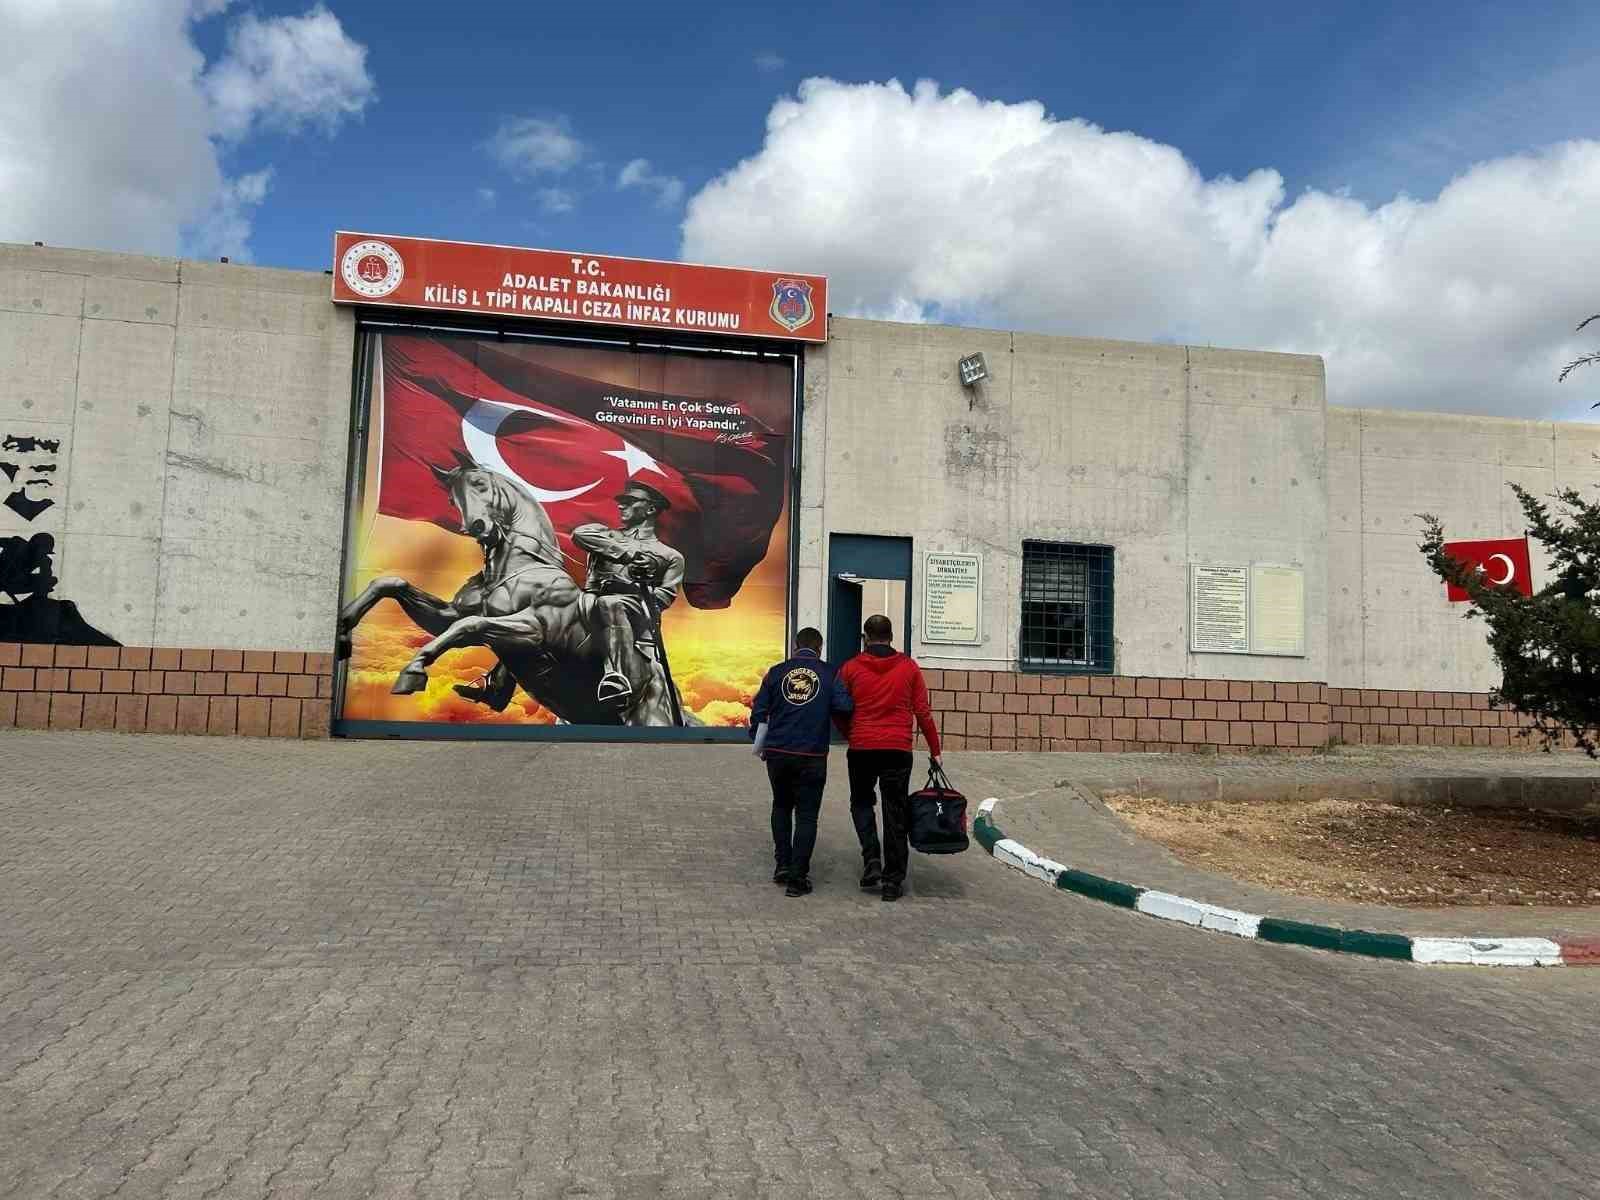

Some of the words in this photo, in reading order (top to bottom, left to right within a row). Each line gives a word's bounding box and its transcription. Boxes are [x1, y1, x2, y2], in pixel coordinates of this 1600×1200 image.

[572, 258, 605, 276] T.C.
[502, 273, 571, 293] ADALET
[577, 280, 670, 302] BAKANLIĞI
[424, 284, 467, 305] KİLİS
[472, 291, 480, 305] L
[486, 289, 517, 308] TİPİ
[523, 294, 577, 314] KAPALI
[583, 300, 622, 318] CEZA
[627, 301, 671, 323] İNFAZ
[676, 309, 739, 329] KURUMU
[662, 401, 675, 411] En
[679, 401, 701, 414] Çok
[705, 404, 741, 415] Seven
[596, 412, 646, 425] Görevini
[650, 416, 664, 426] En
[668, 414, 682, 429] İyi
